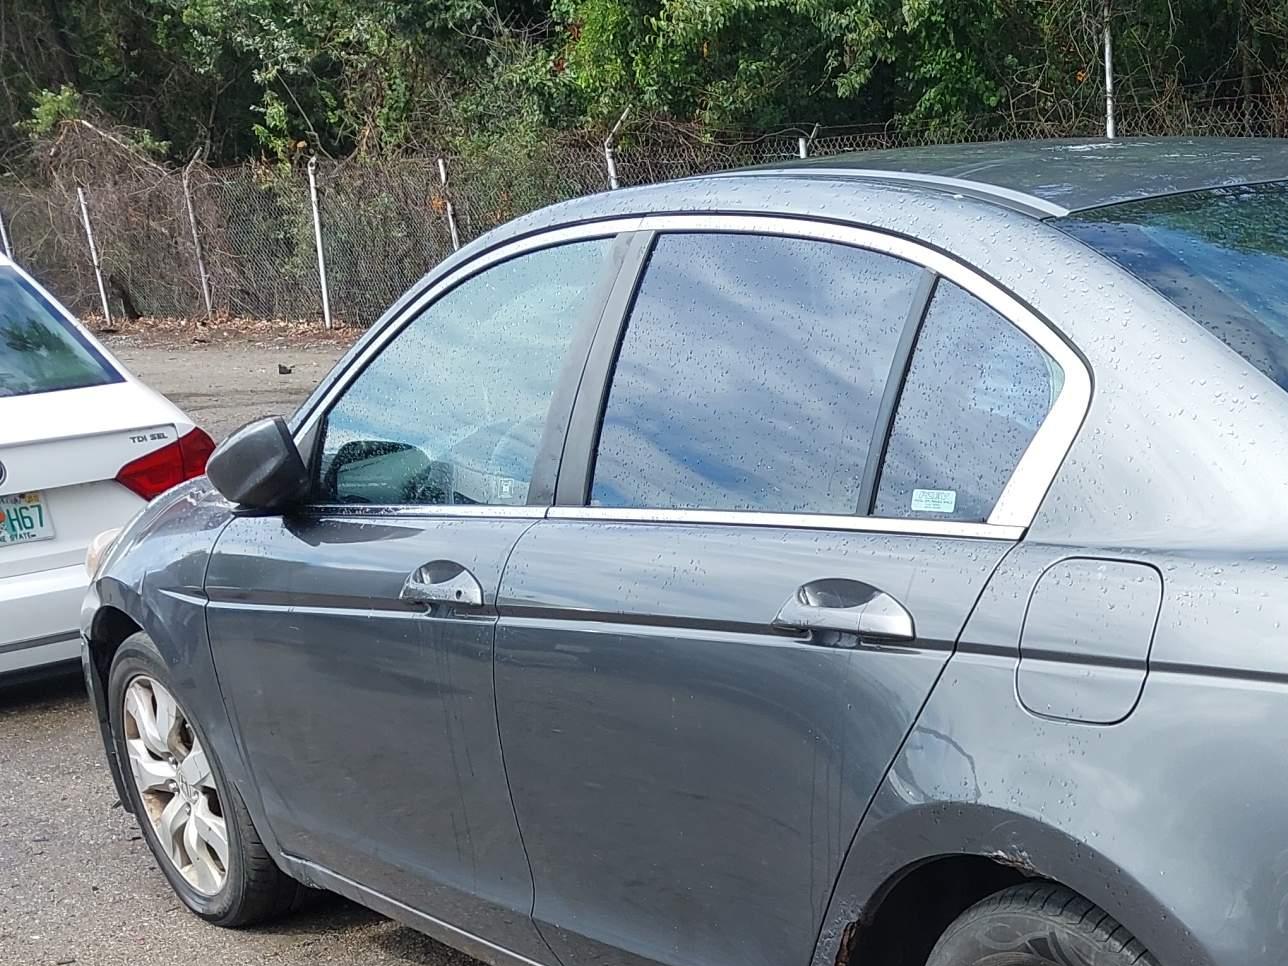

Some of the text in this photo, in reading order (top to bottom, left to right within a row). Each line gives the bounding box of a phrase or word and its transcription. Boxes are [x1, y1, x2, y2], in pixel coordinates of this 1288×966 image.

[129, 432, 168, 443] TDI SEL
[6, 504, 44, 532] H67
